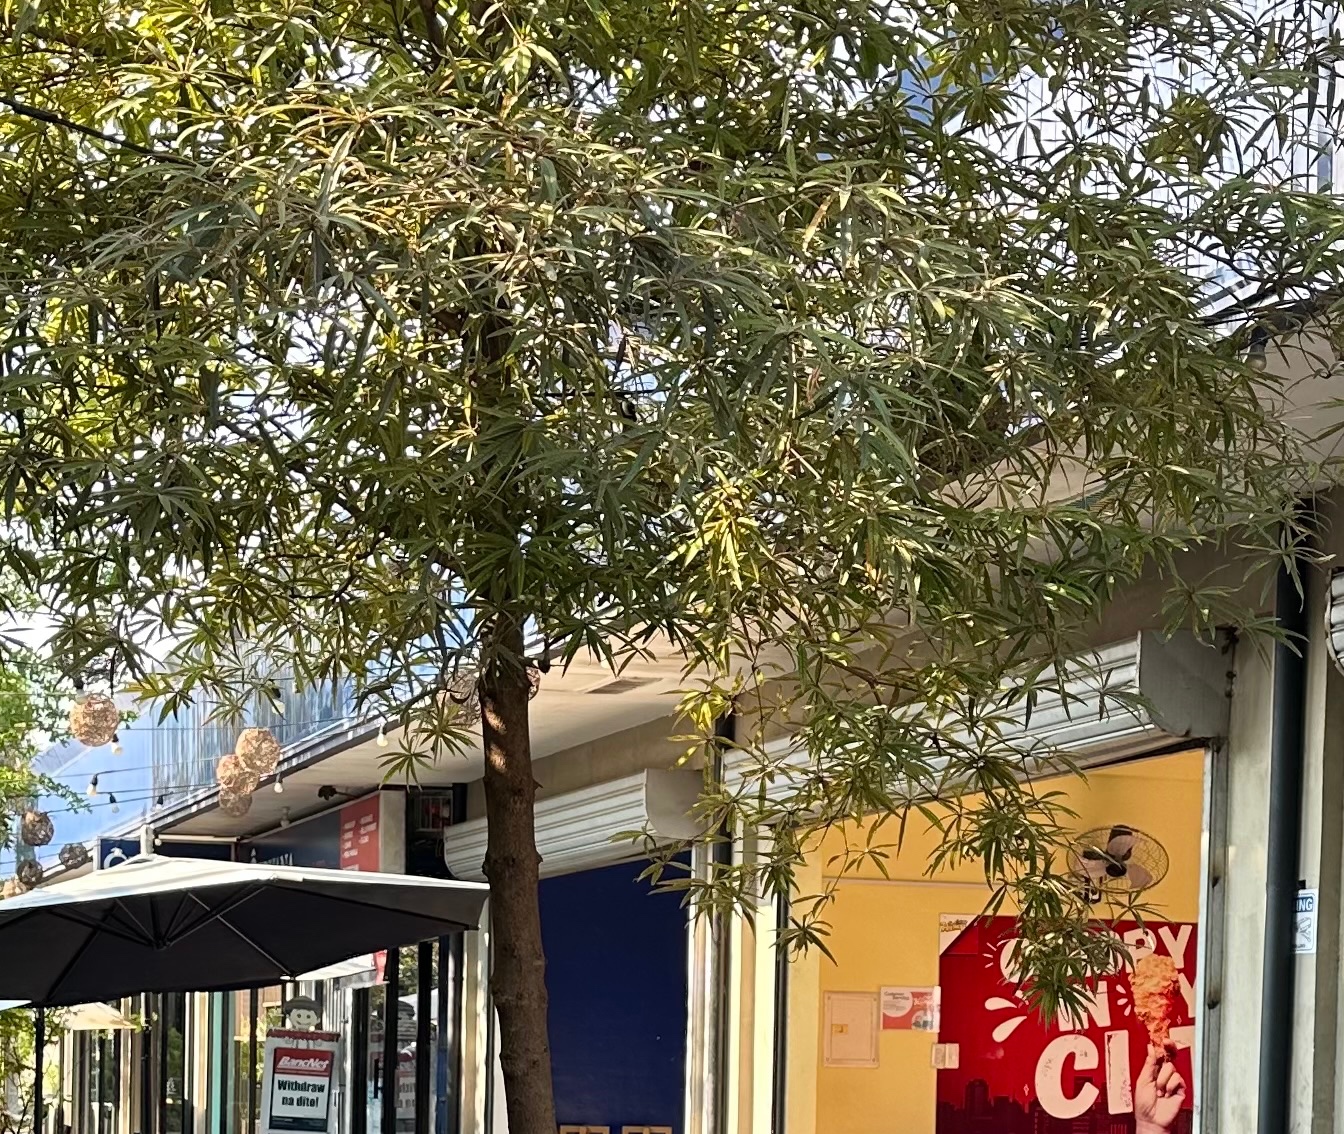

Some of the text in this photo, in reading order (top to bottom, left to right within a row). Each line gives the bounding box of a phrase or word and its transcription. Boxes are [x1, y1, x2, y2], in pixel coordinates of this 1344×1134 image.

[276, 1056, 329, 1071] BancNet
[277, 1079, 325, 1093] Withdraw
[282, 1096, 294, 1106] na
